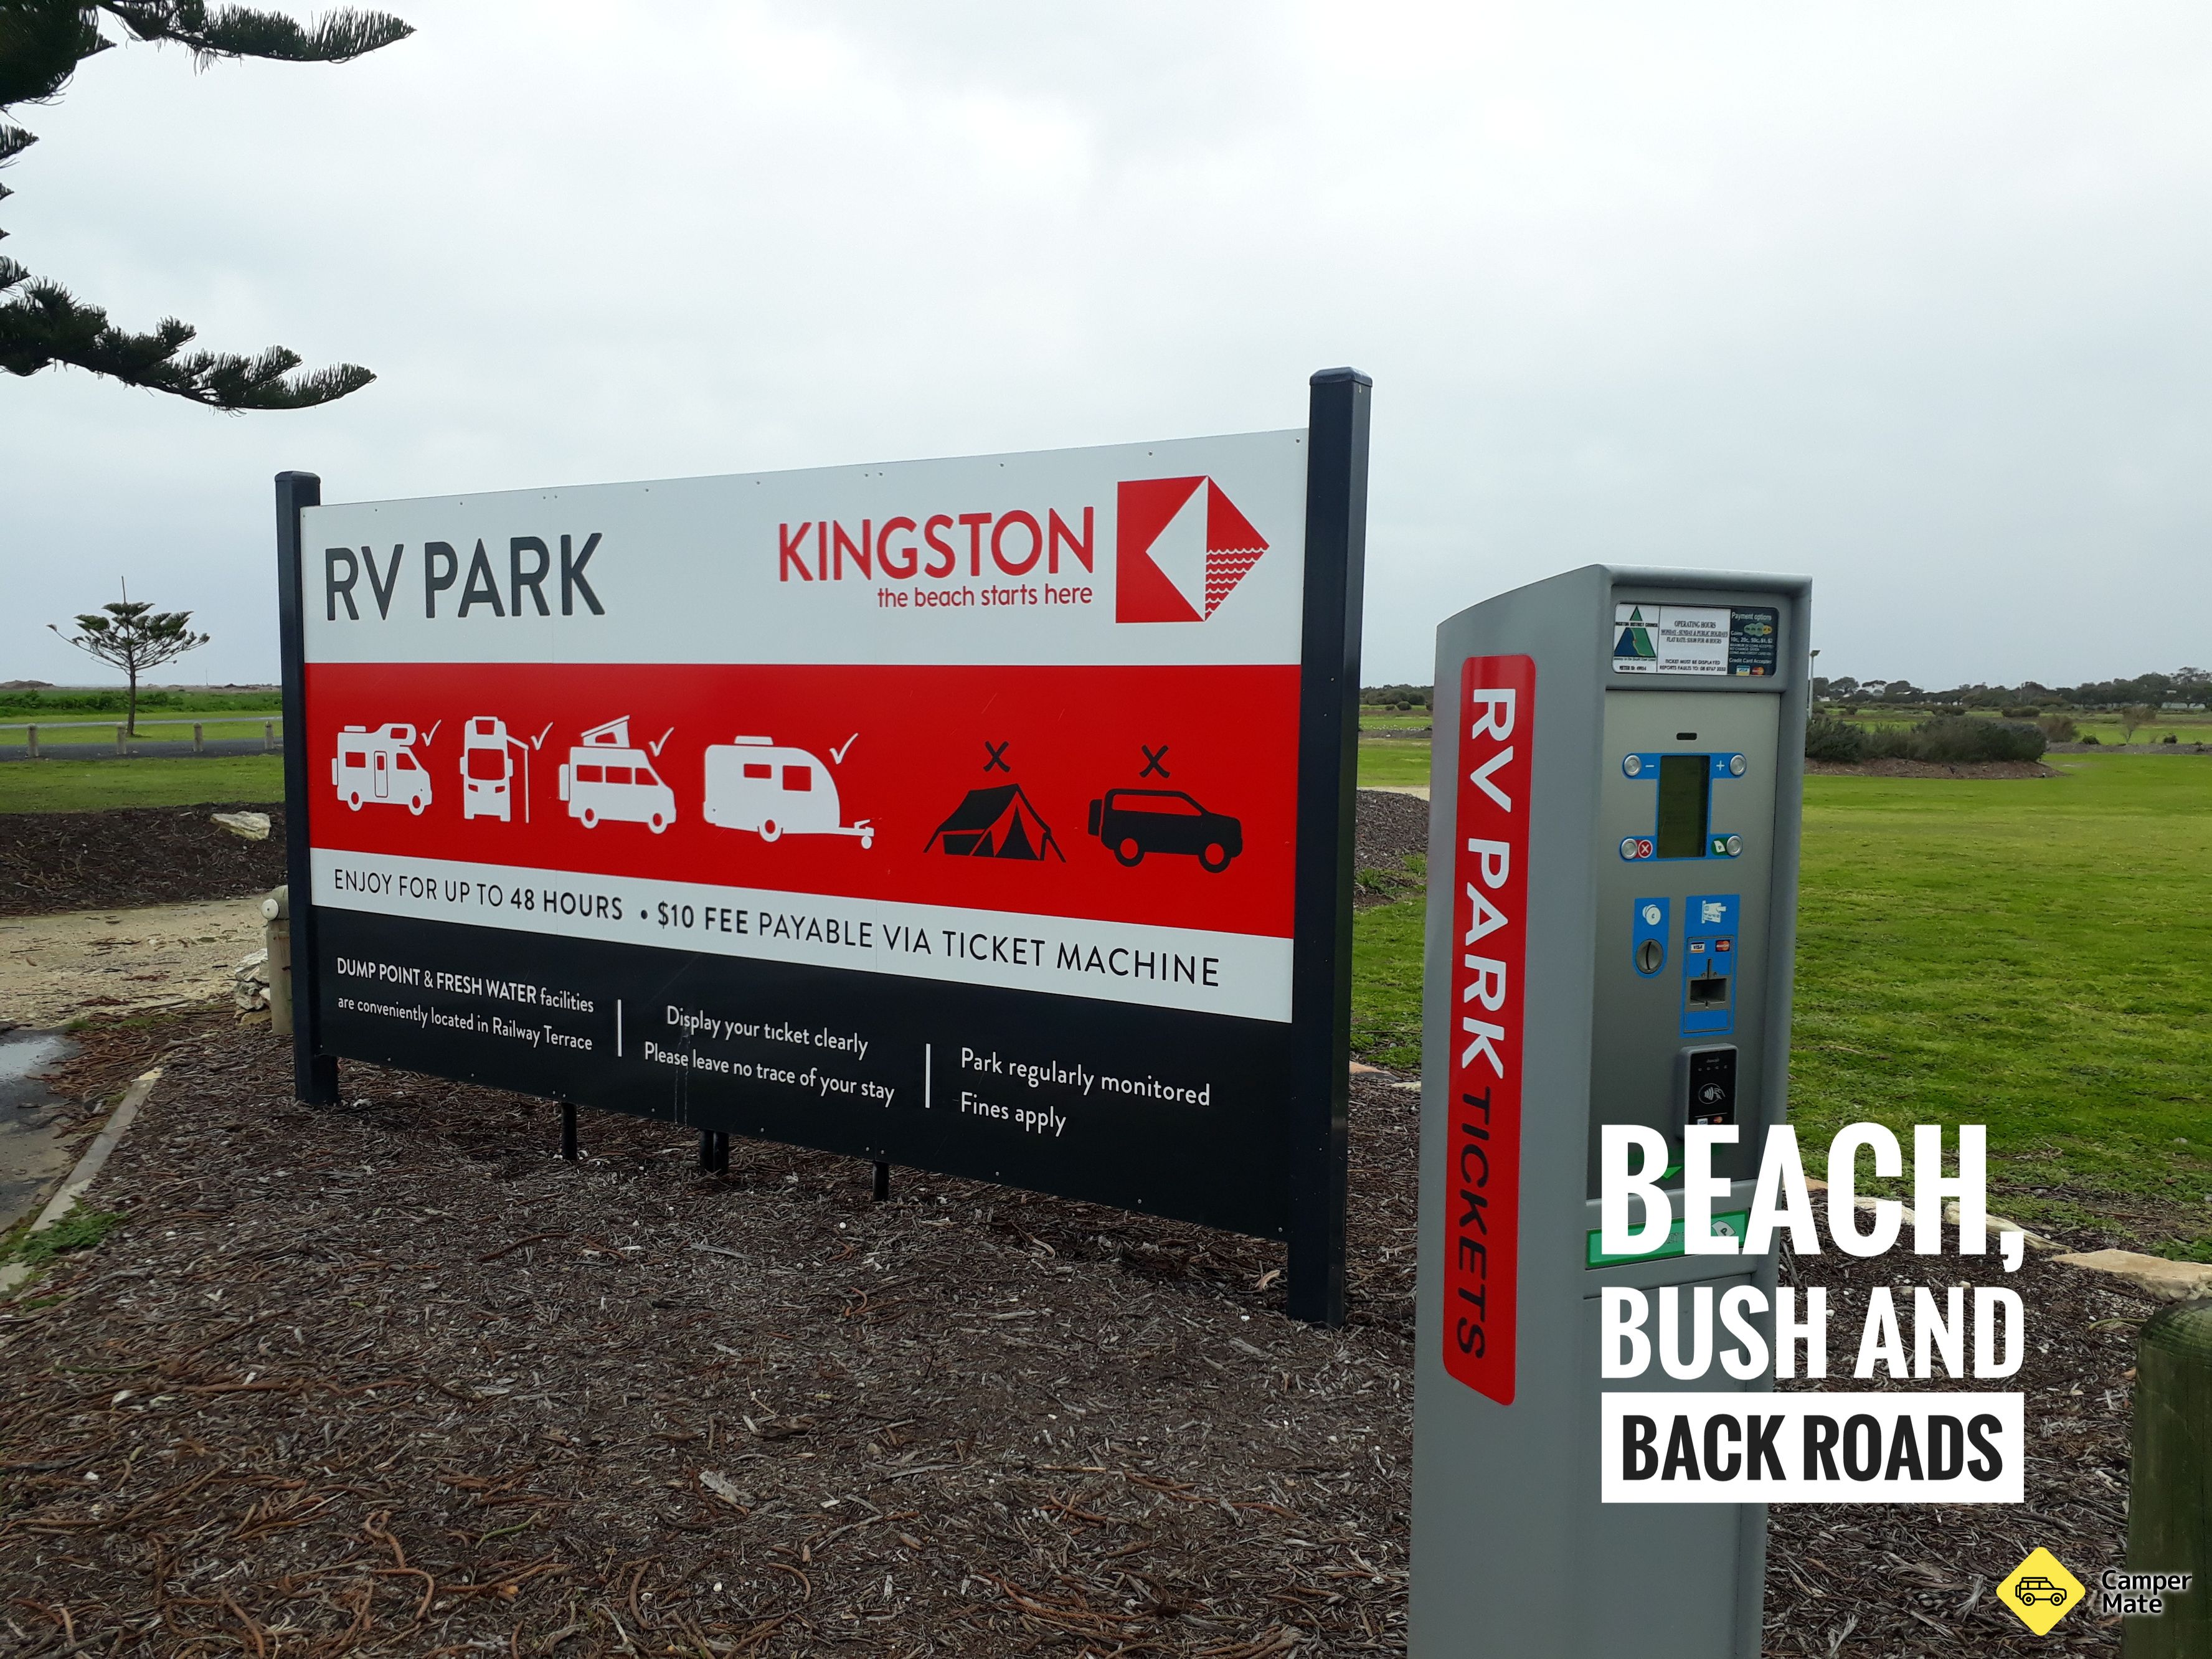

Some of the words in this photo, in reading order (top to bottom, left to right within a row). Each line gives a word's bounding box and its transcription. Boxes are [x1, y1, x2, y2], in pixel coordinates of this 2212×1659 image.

[780, 507, 1094, 582] KINGSTON
[326, 544, 404, 621] RV
[425, 533, 605, 618] PARK
[878, 588, 907, 607] the
[915, 586, 974, 607] beach
[981, 584, 1037, 605] starts
[1046, 584, 1092, 604] here
[1732, 612, 1753, 620] Payment
[1470, 689, 1516, 812] RV
[335, 869, 392, 894] ENJOY
[400, 876, 437, 899] FOR
[446, 881, 470, 902] UP
[477, 884, 503, 906] TO
[511, 888, 534, 910] 48
[544, 891, 622, 920] HOURS
[658, 901, 694, 929] $10
[706, 907, 747, 933] FEE
[760, 912, 872, 947] PAYABLE
[883, 925, 931, 954] VIA
[943, 931, 1045, 966] TICKET
[1057, 942, 1219, 986] MACHINE
[1462, 838, 1510, 1079] PARK
[338, 958, 376, 978] DUMP
[380, 964, 420, 985] POINT
[424, 971, 433, 988] &
[437, 972, 481, 995] FRESH
[486, 980, 536, 1003] WATER
[541, 988, 593, 1012] facilities
[339, 998, 354, 1009] are
[357, 1001, 428, 1028] conveniently
[432, 1007, 473, 1030] located
[478, 1015, 488, 1033] in
[493, 1017, 540, 1047] Railway
[544, 1025, 592, 1050] Terrace
[668, 1006, 721, 1038] Display
[725, 1021, 760, 1040] your
[764, 1022, 809, 1044] ticket
[815, 1028, 868, 1060] clearly
[646, 1041, 688, 1066] Please
[693, 1049, 729, 1072] leave
[734, 1064, 752, 1076] no
[757, 1064, 795, 1084] trace
[800, 1067, 817, 1086] of
[820, 1077, 857, 1096] your
[862, 1082, 894, 1107] stay
[962, 1047, 1002, 1073] Park
[1009, 1061, 1094, 1095] regularly
[1102, 1075, 1209, 1105] monitored
[962, 1092, 1008, 1119] Fines
[1016, 1106, 1066, 1137] apply
[1457, 1087, 1490, 1358] TICKETS
